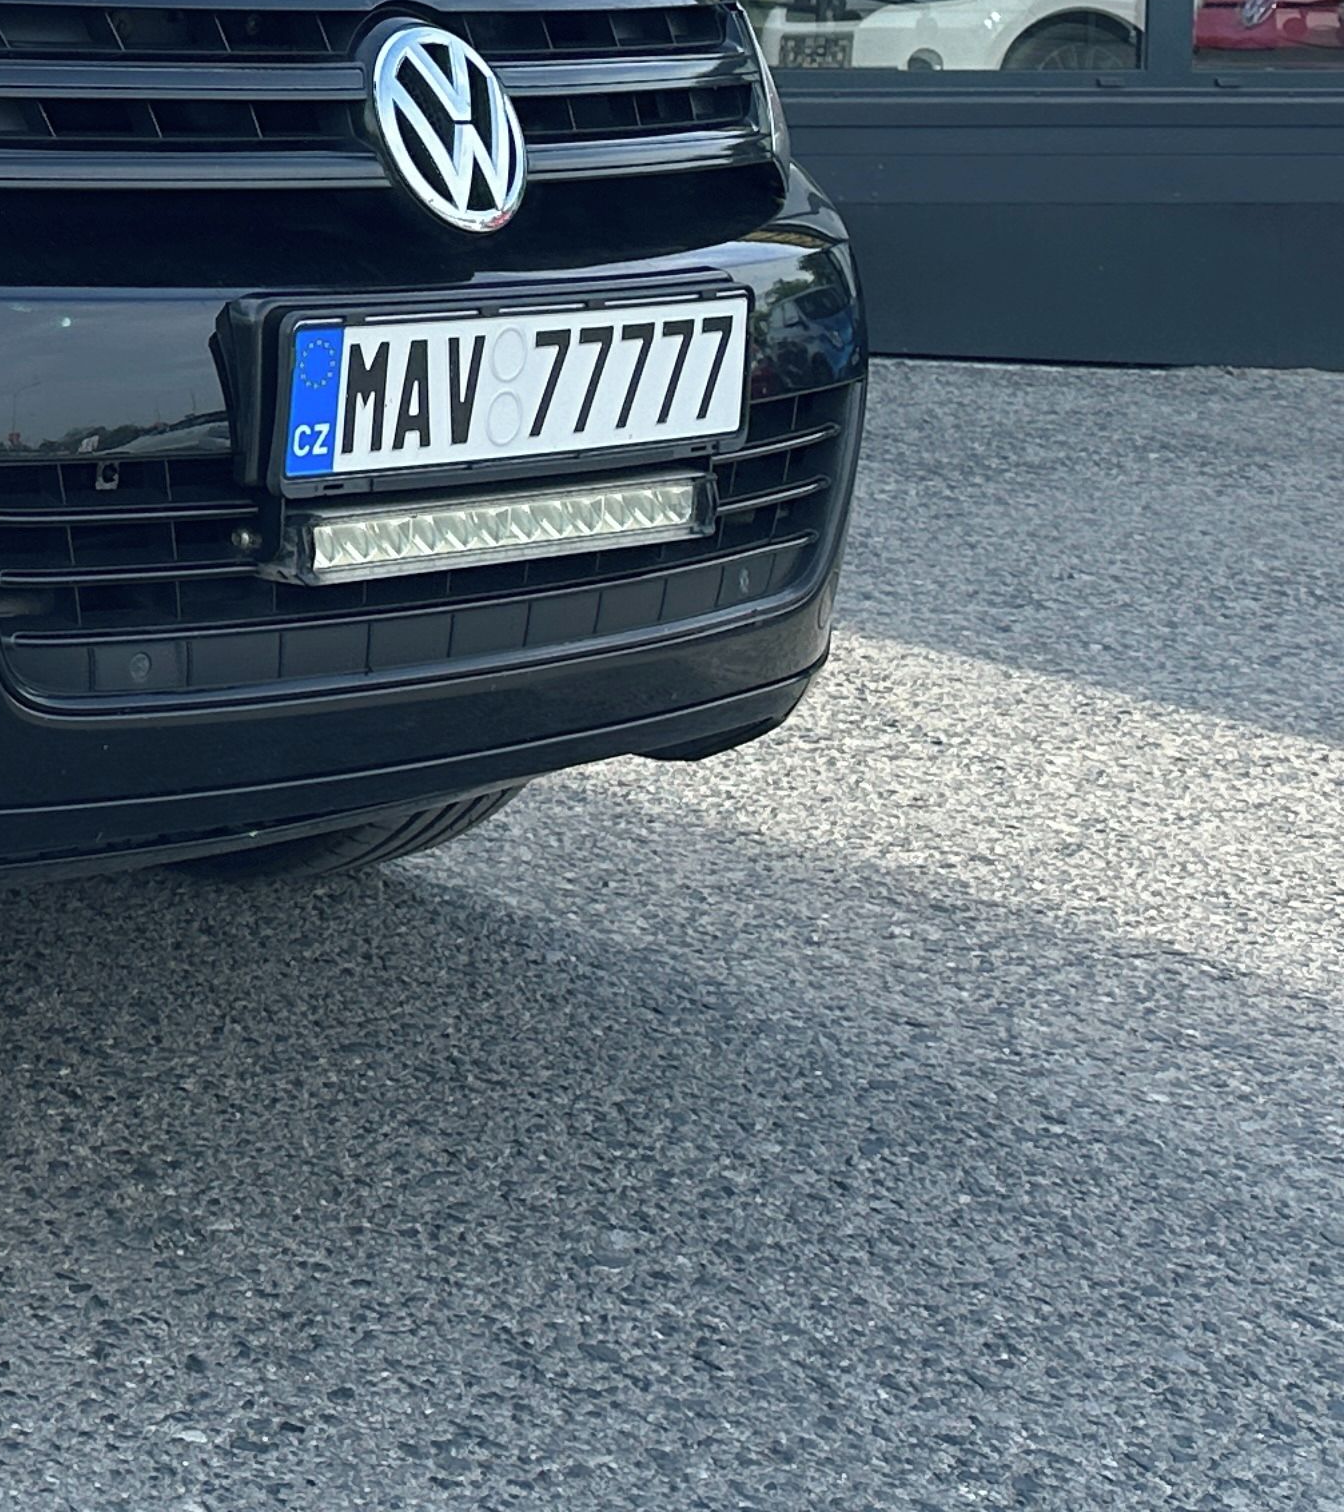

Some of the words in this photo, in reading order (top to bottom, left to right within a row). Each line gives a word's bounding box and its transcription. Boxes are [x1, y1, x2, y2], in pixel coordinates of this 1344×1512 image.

[341, 335, 487, 454] MAV
[529, 315, 734, 438] 77777
[293, 422, 331, 457] CZ
